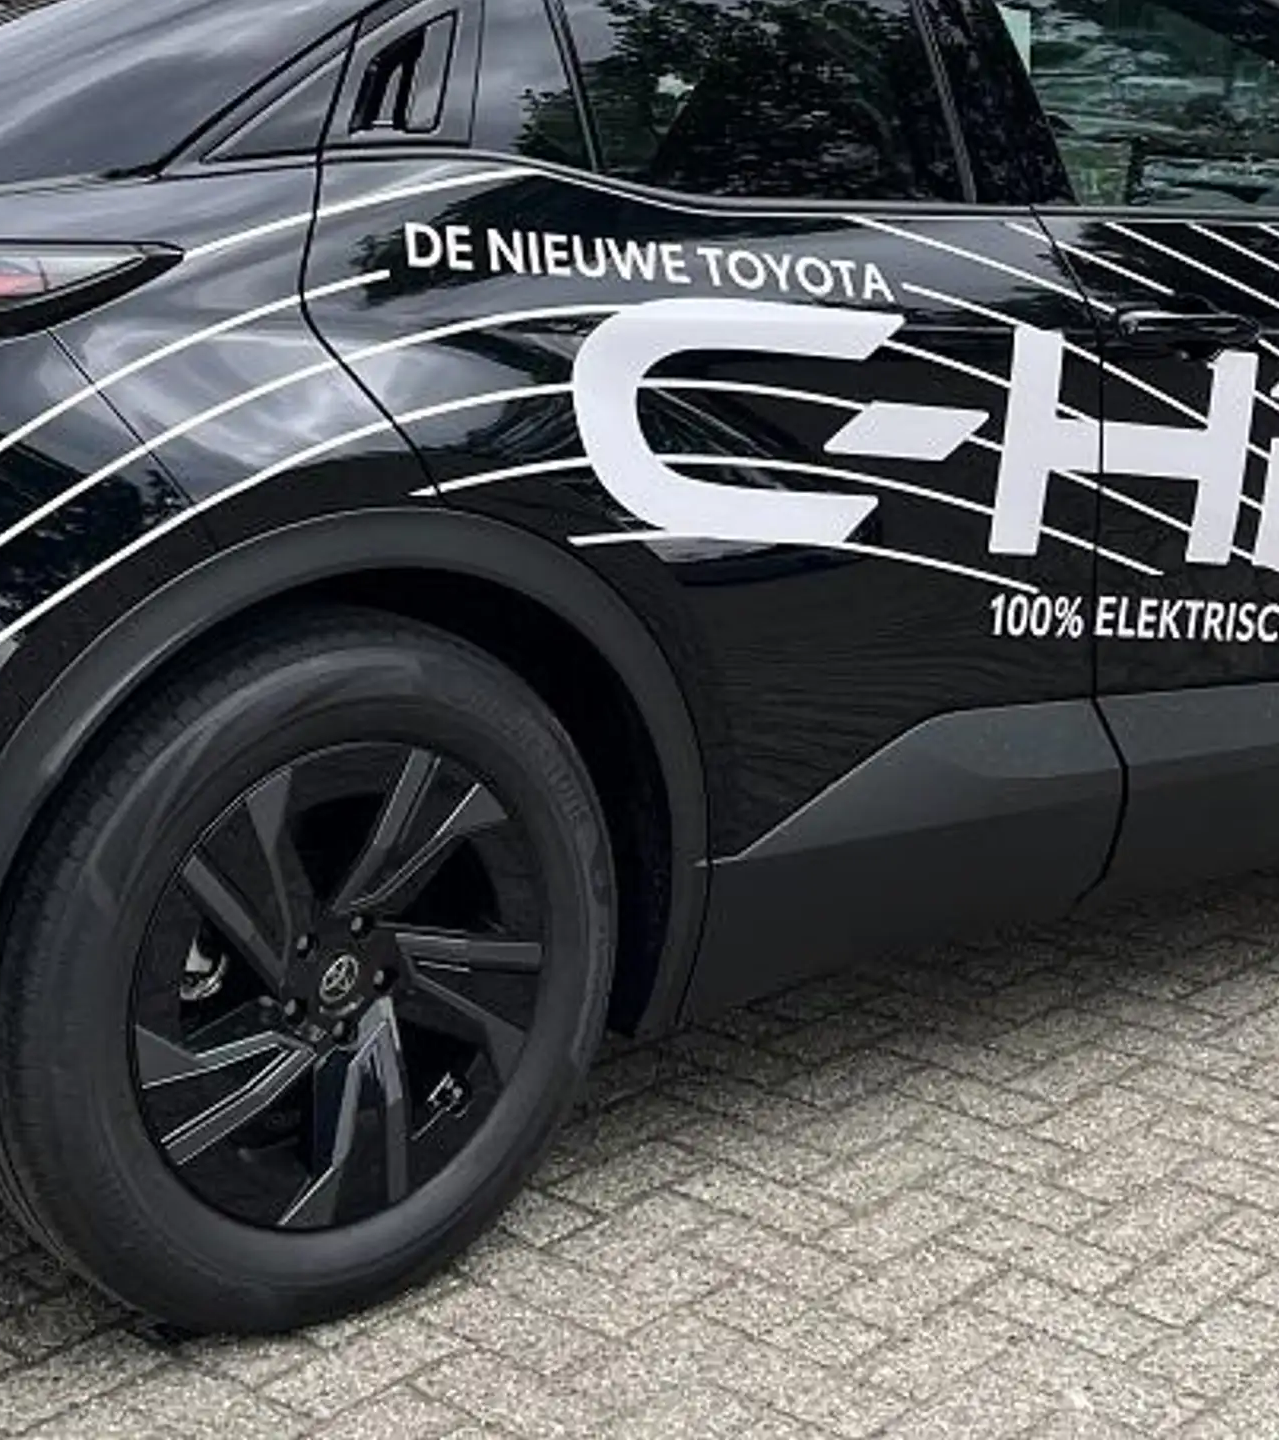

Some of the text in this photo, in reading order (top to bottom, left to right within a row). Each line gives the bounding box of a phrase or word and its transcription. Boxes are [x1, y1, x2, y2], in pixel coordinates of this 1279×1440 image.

[404, 222, 895, 302] DE NIEUWE TOYOTA
[989, 593, 1084, 639] 100%
